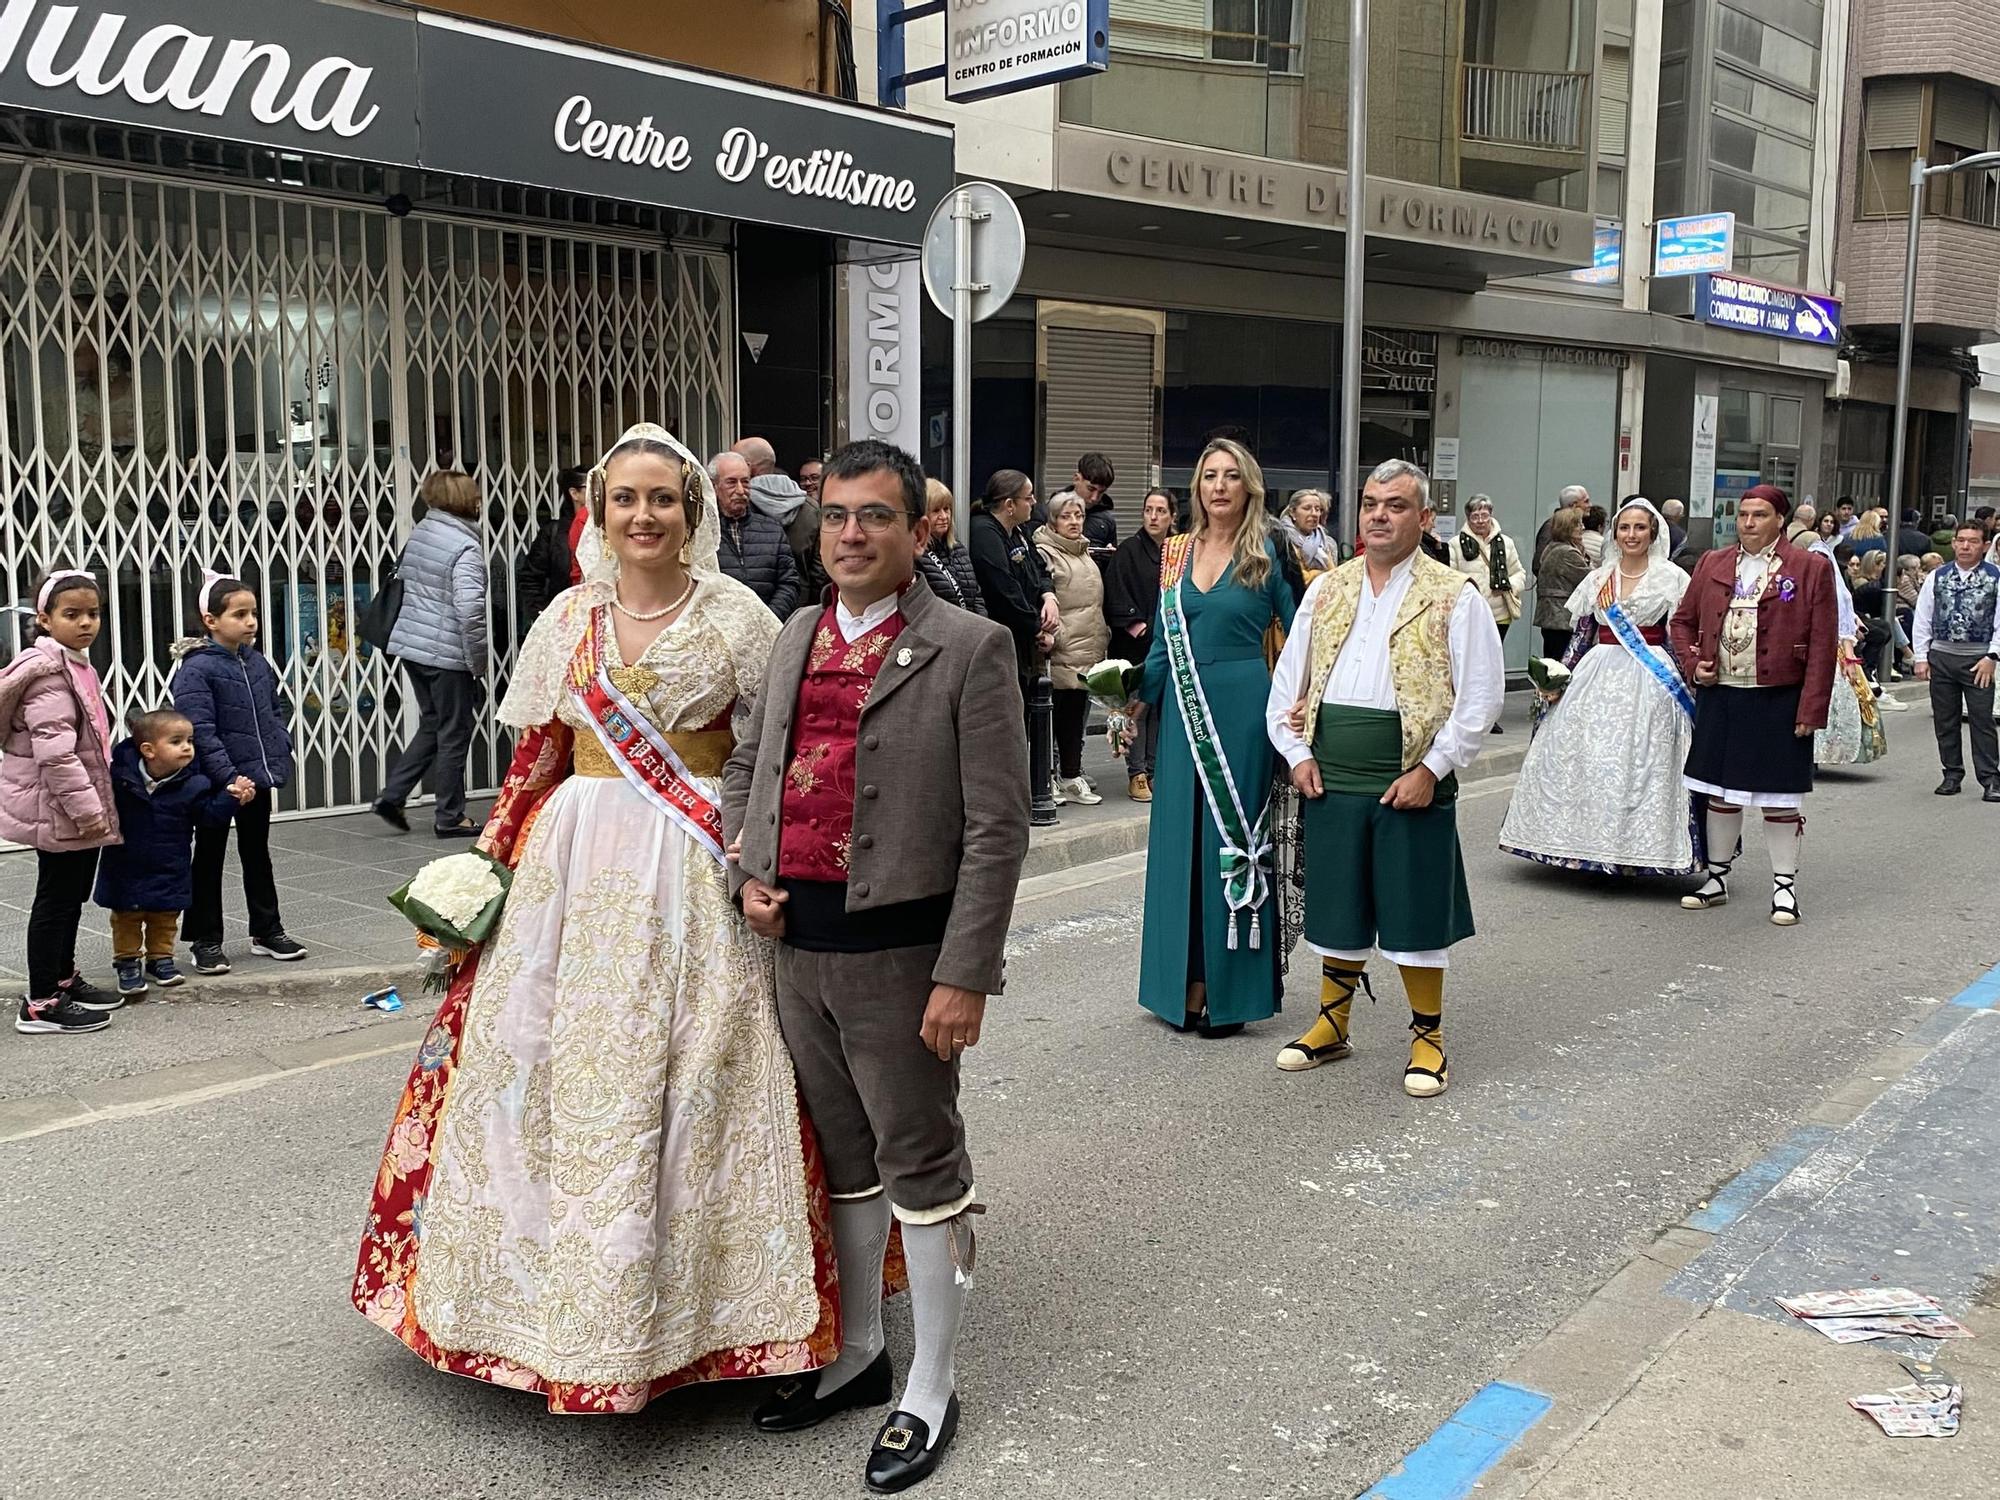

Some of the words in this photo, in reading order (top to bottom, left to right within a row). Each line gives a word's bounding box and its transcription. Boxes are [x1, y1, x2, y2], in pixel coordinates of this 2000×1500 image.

[953, 1, 1082, 59] INFORMO
[955, 61, 996, 81] CENTRO
[999, 57, 1013, 70] DE
[1016, 41, 1081, 66] FORMACIÓN
[554, 95, 692, 172] Centre
[714, 127, 917, 212] D'estilisme
[1106, 150, 1280, 206] CENTRE
[1710, 277, 1737, 300] CENTRO
[1738, 282, 1796, 311] RECONOCIMIENTO
[1709, 300, 1760, 326] CONDUCTORES
[1759, 311, 1765, 327] Y
[1766, 311, 1790, 331] ARMAS
[1367, 346, 1421, 366] NOVO
[1181, 674, 1191, 685] de
[627, 737, 698, 809] Padrina
